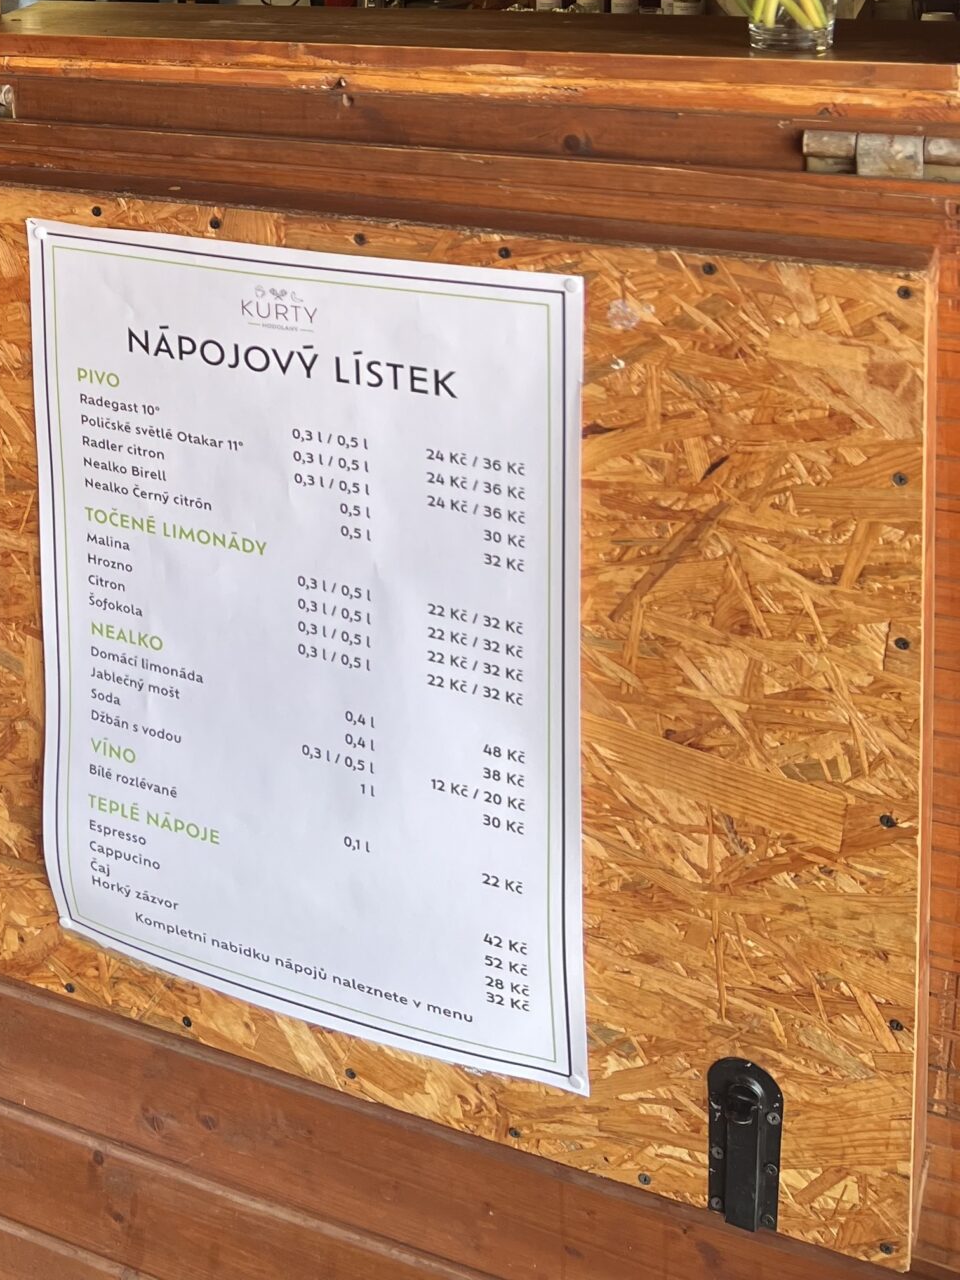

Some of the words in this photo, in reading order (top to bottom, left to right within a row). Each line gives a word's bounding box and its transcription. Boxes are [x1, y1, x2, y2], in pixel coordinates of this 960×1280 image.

[241, 299, 317, 324] KURTY
[127, 326, 318, 378] NÁPOJOVÝ
[335, 351, 457, 398] LÍSTEK
[77, 368, 120, 388] PIVO
[79, 394, 138, 413] Radegast
[80, 414, 131, 433] Poličské
[135, 426, 173, 440] světlé
[176, 432, 224, 448] Otakar
[291, 429, 313, 442] 0,3
[337, 435, 359, 449] 0,5
[81, 436, 123, 452] Radler
[126, 444, 165, 460] citron
[83, 457, 127, 474] Nealko
[131, 466, 166, 481] Birell
[84, 478, 129, 495] Nealko
[132, 484, 169, 505] Černý
[84, 507, 156, 534] TOČENÉ
[163, 522, 266, 556] LIMONÁDY
[86, 533, 130, 551] Malina
[483, 530, 502, 543] 30
[507, 534, 525, 548] Kč
[87, 553, 133, 572] Hrozno
[483, 553, 501, 567] 32
[505, 558, 524, 572] Kč
[87, 575, 125, 592] Citron
[88, 596, 143, 617] Šofokola
[91, 622, 163, 651] NEALKO
[90, 646, 138, 667] Domácí
[141, 658, 204, 684] limonáda
[90, 668, 144, 692] Jablečný
[147, 684, 180, 699] mošt
[90, 688, 121, 706] Soda
[90, 710, 129, 730] Džbán
[141, 726, 181, 744] vodou
[90, 738, 136, 763] VÍNO
[482, 744, 502, 758] 48
[507, 749, 525, 764] Kč
[89, 764, 112, 780] Bílé
[115, 774, 177, 798] rozlévané
[482, 768, 501, 782] 38
[506, 772, 524, 788] Kč
[87, 794, 139, 822] TEPLÉ
[146, 811, 220, 845] NÁPOJE
[482, 814, 501, 828] 30
[506, 820, 524, 835] Kč
[89, 820, 146, 845] Espresso
[89, 841, 160, 870] Cappucino
[90, 858, 110, 877] Čaj
[91, 875, 131, 898] Horký
[135, 891, 179, 910] zázvor
[481, 873, 500, 888] 22
[505, 880, 523, 894] Kč
[483, 934, 503, 948] 42
[508, 940, 527, 955] Kč
[135, 912, 206, 943] Kompletní
[274, 958, 327, 980] nápojů
[332, 976, 408, 1005] naleznete
[426, 1004, 473, 1023] menu
[484, 955, 503, 970] 52
[508, 962, 528, 976] Kč
[484, 976, 504, 990] 28
[509, 982, 529, 997] Kč
[485, 992, 504, 1006] 32
[509, 998, 529, 1012] Kč
